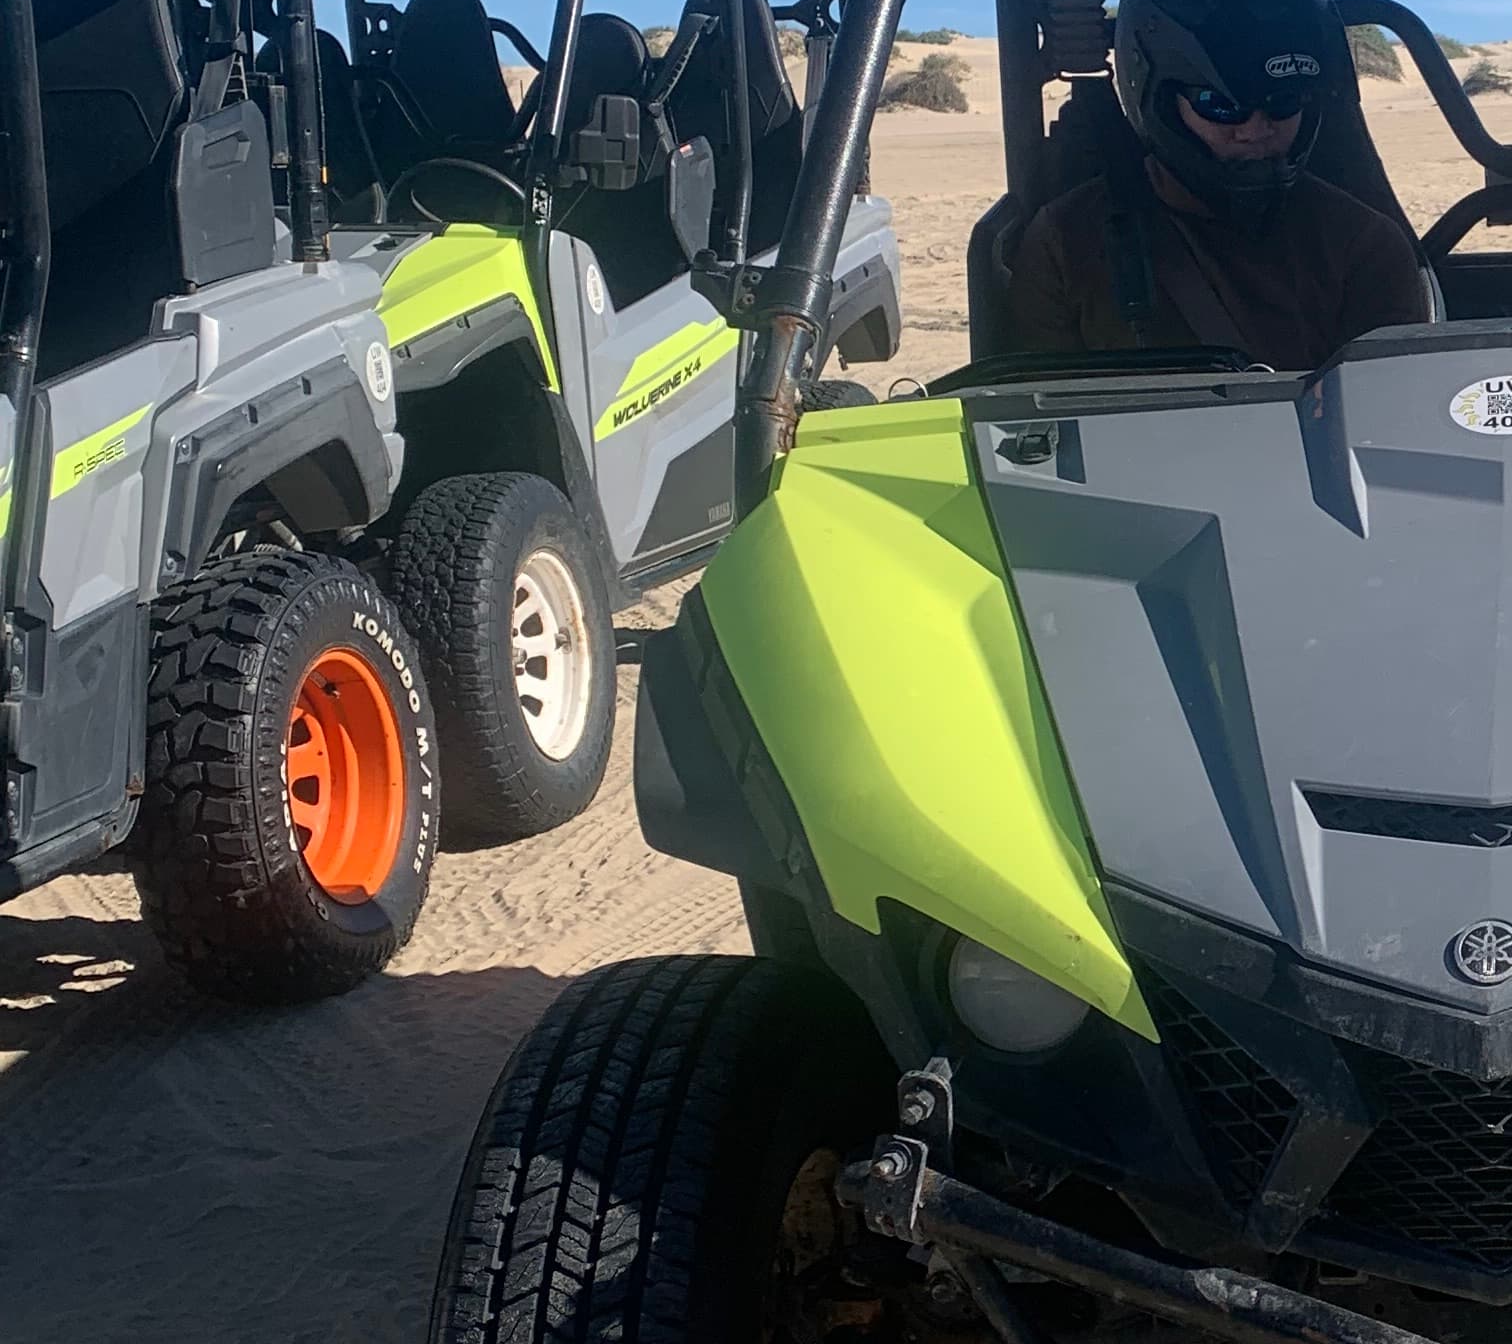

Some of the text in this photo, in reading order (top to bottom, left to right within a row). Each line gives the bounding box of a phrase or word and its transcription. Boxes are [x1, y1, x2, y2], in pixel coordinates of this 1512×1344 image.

[353, 611, 432, 874] KOMODO M/T PLUS
